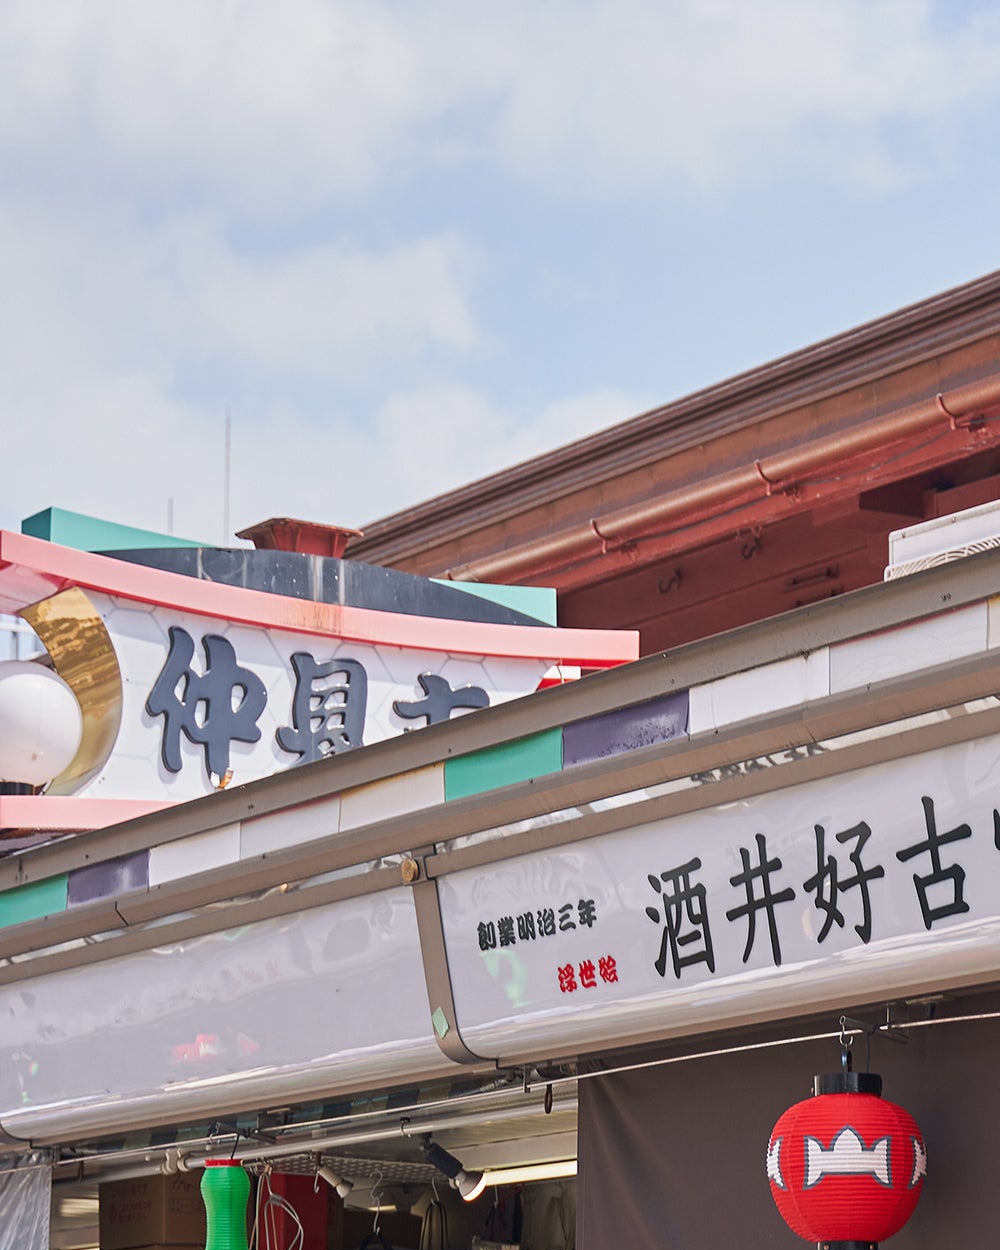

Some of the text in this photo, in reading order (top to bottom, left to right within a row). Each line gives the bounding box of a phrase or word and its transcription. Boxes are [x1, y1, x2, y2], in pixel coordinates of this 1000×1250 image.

[477, 898, 598, 952] 創業明治三年
